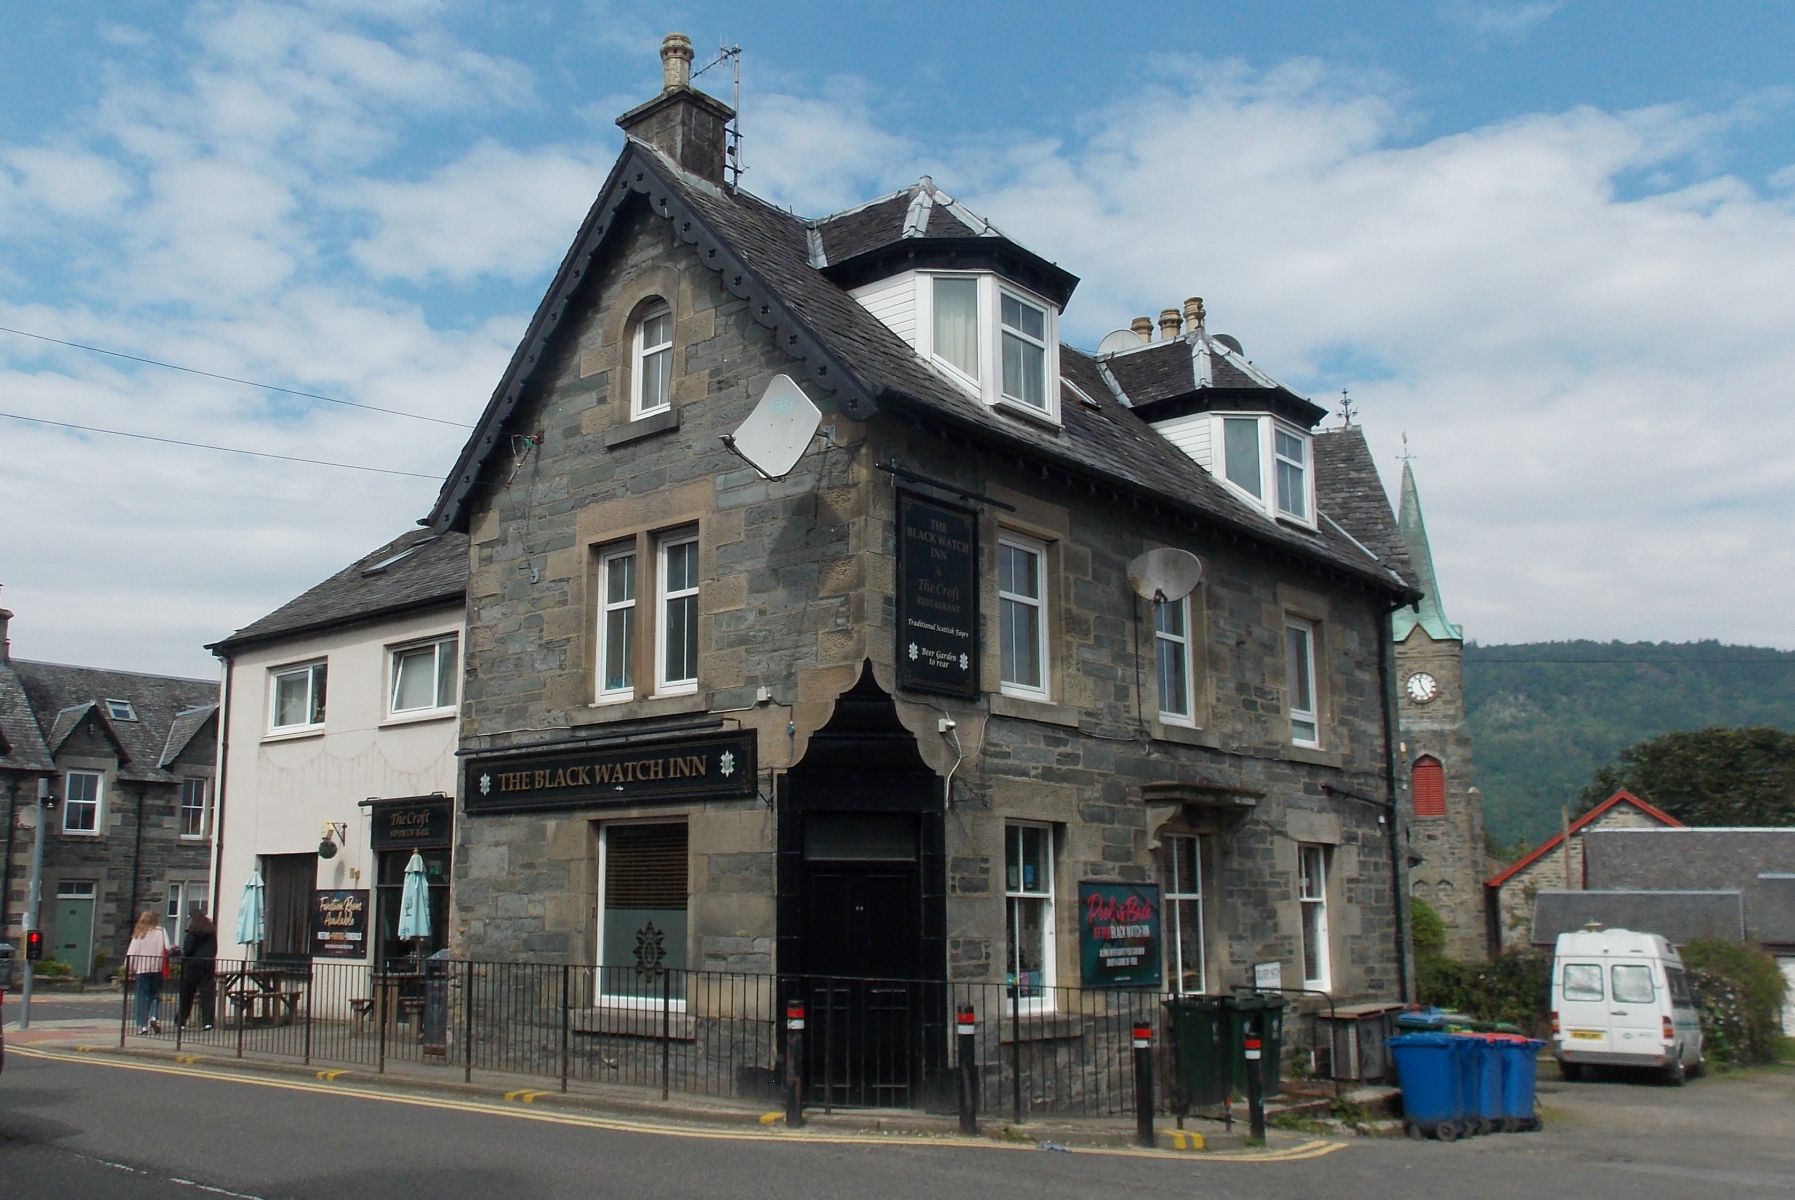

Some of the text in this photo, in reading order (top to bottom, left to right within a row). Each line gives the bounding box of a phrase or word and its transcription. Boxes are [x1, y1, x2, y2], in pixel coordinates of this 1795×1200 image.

[931, 519, 948, 533] THE
[907, 527, 969, 553] BLACK WATCH
[930, 547, 948, 560] INN
[917, 577, 961, 601] The Croft
[916, 595, 961, 614] RESTAURANT
[908, 618, 936, 631] Traditional
[936, 623, 954, 635] Scottish
[921, 647, 957, 663] Beer Garden
[929, 657, 950, 669] to rear
[498, 755, 708, 792] THE BLACK WATCH INN
[390, 808, 430, 829] The Croft
[1087, 892, 1116, 926] Pool
[1124, 895, 1152, 921] Back
